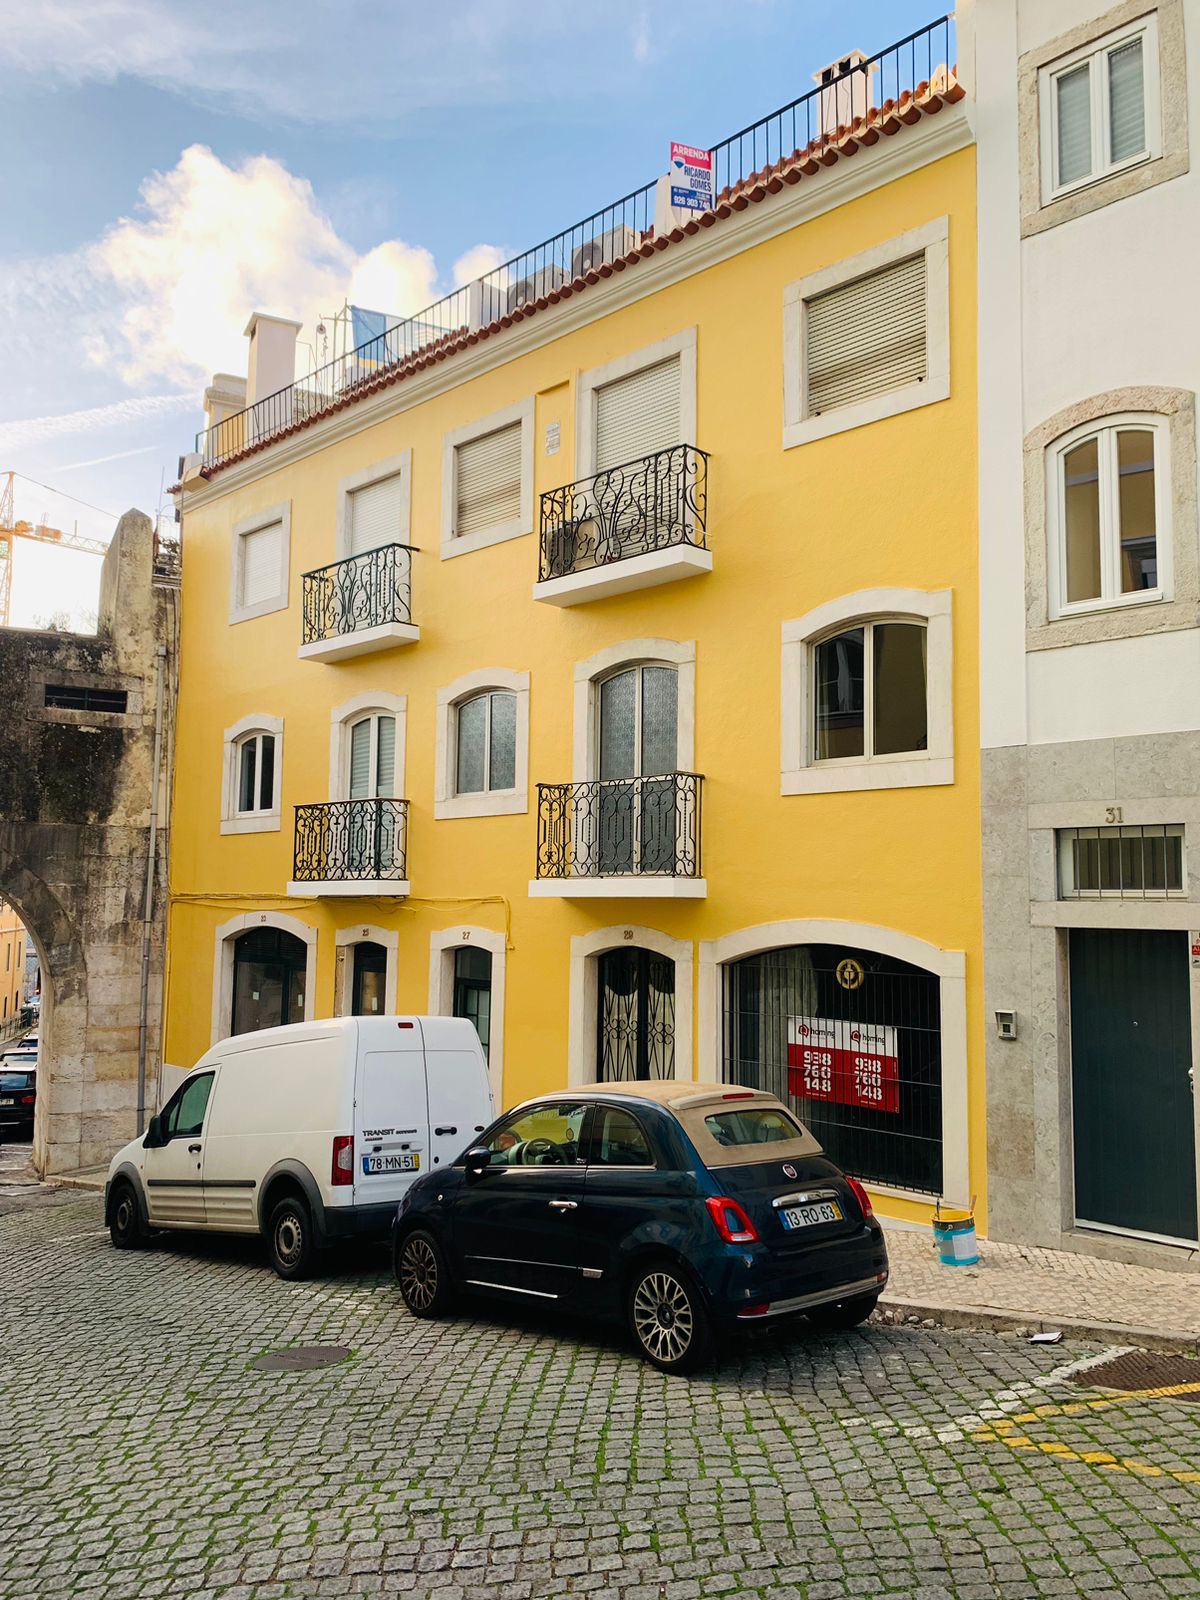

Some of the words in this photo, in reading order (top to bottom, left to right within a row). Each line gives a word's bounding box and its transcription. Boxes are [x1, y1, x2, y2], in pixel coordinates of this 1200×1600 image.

[672, 144, 709, 161] ARRENDA
[684, 166, 711, 181] RICARDO
[690, 178, 711, 192] GOMES
[1105, 806, 1124, 824] 31
[462, 931, 471, 940] 27
[623, 930, 634, 940] 29
[803, 1051, 832, 1067] 938
[854, 1057, 882, 1073] 938
[803, 1064, 831, 1079] 760
[854, 1070, 882, 1087] 760
[803, 1077, 832, 1092] 148
[854, 1084, 883, 1101] 148
